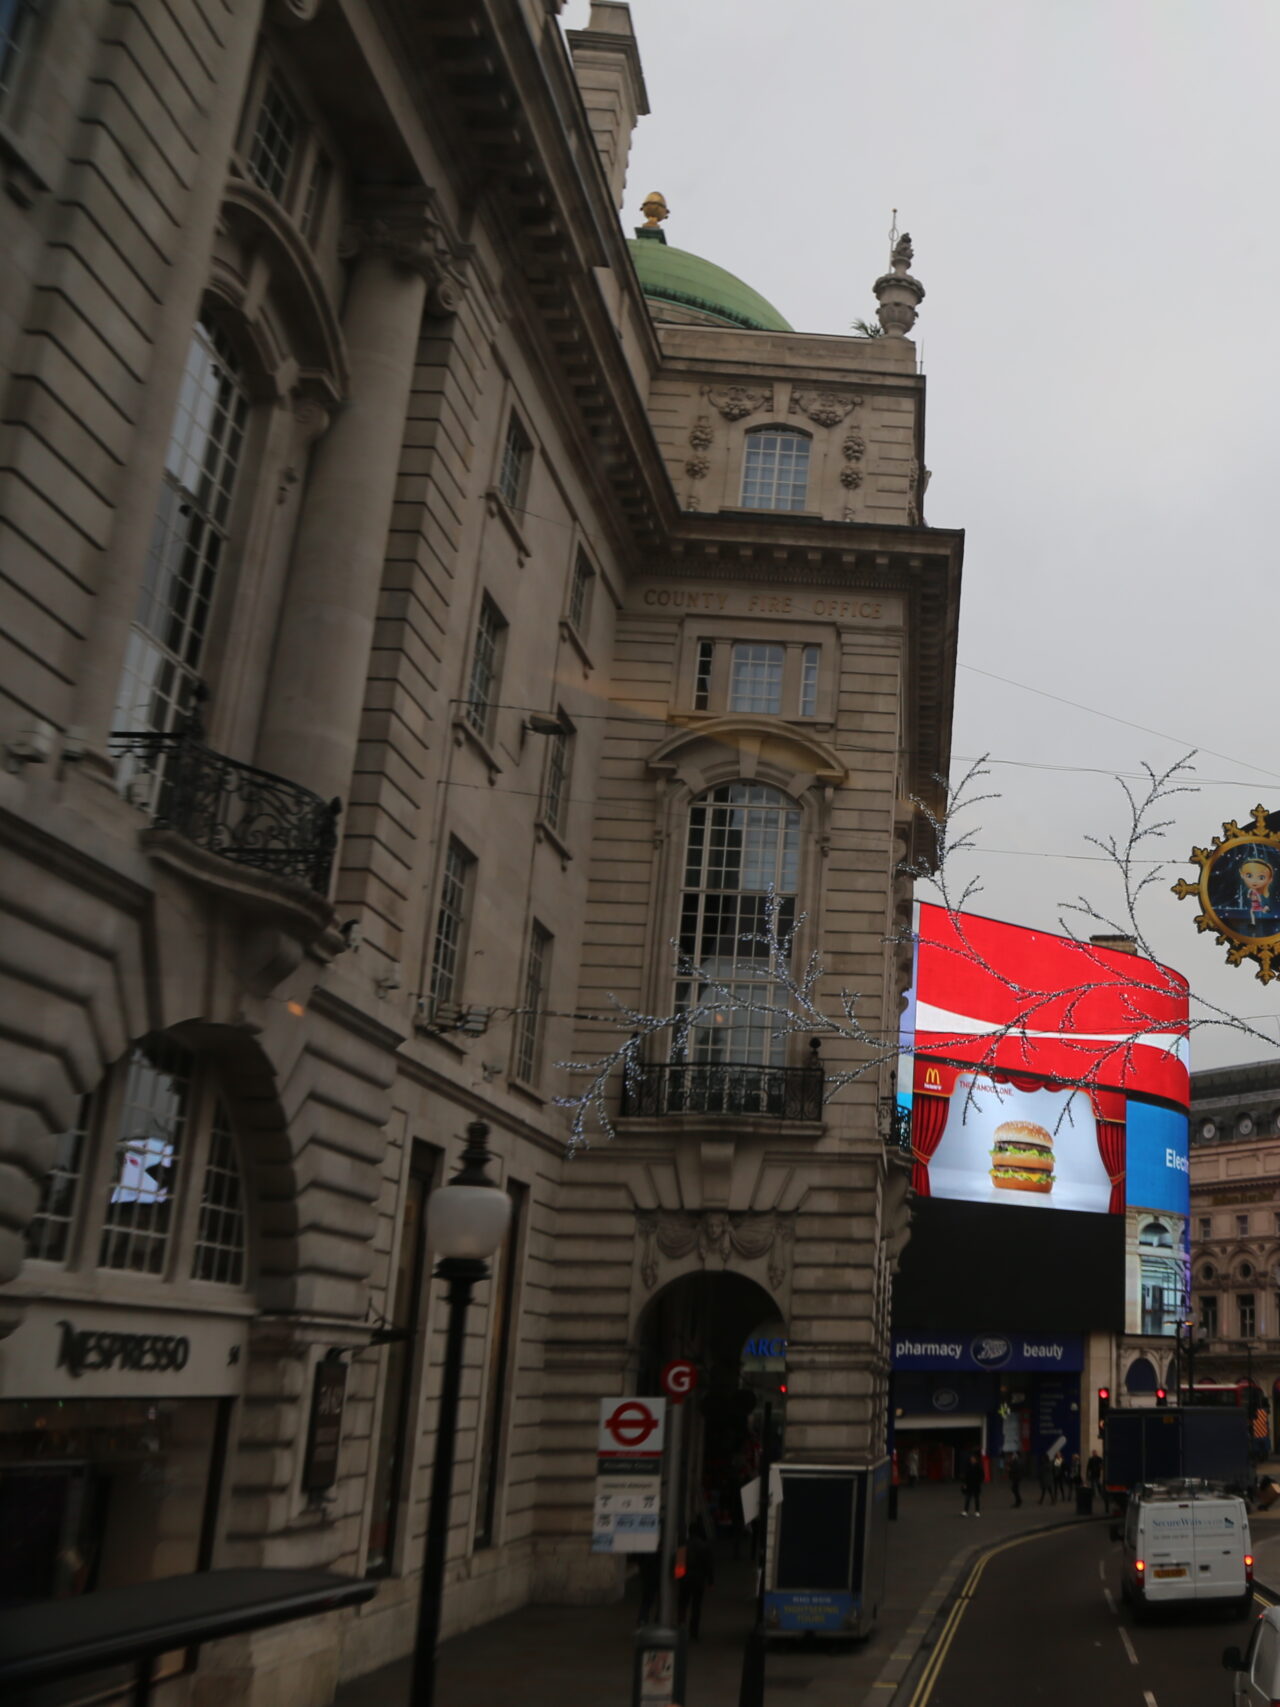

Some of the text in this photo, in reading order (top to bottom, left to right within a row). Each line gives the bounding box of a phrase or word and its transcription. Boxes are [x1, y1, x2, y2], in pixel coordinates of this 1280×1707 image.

[643, 588, 883, 620] COUNTY FIRE OFFICE
[56, 1320, 190, 1378] NESPRESSO
[895, 1340, 962, 1359] pharmacy
[1023, 1342, 1064, 1361] beauty
[666, 1365, 692, 1392] G
